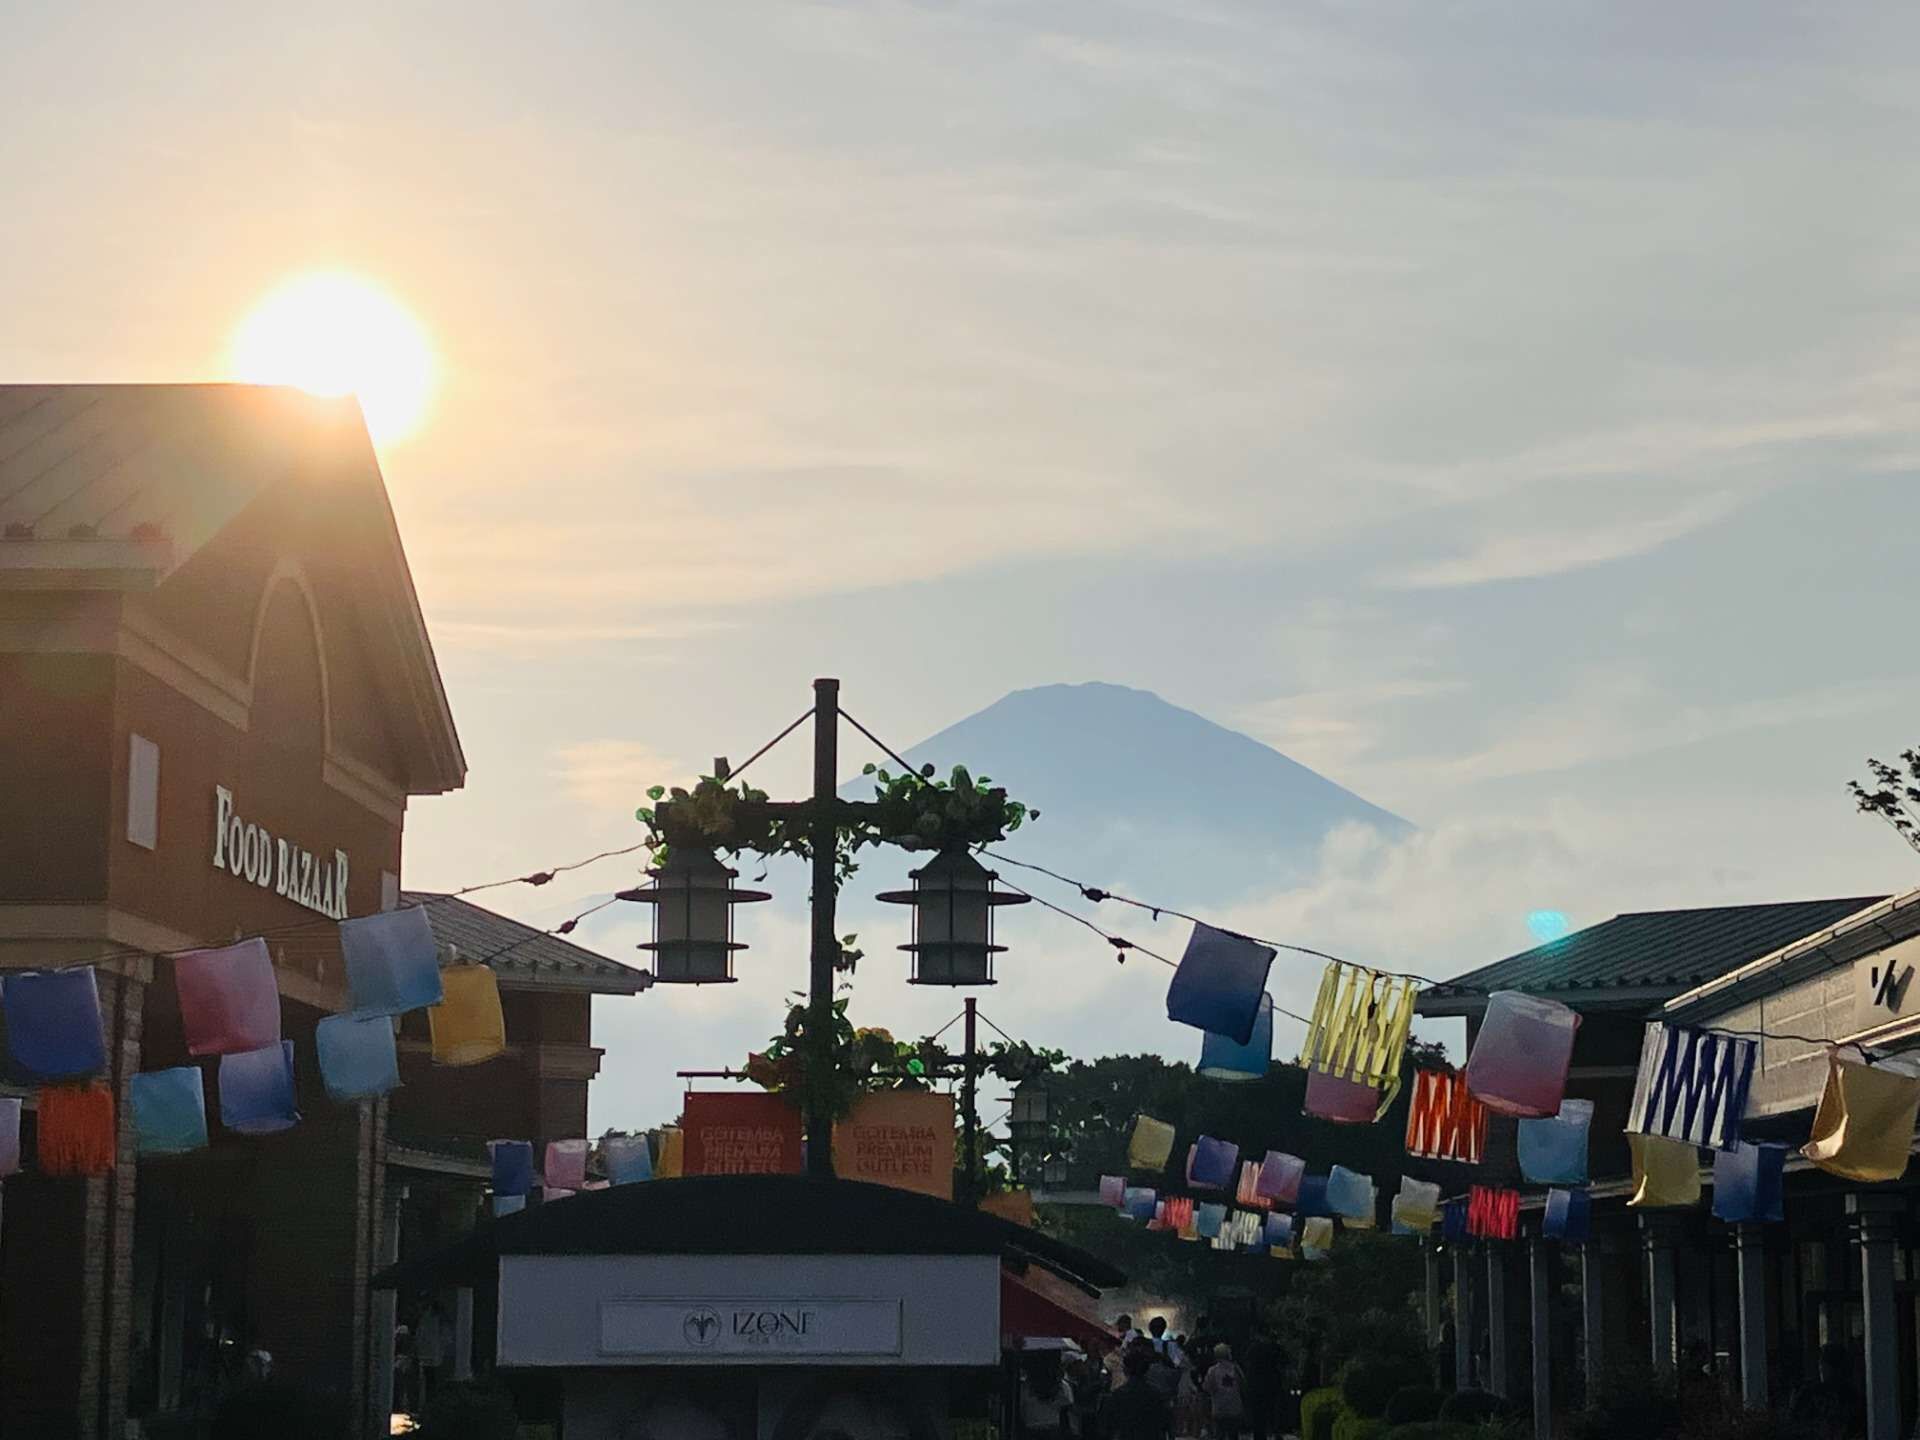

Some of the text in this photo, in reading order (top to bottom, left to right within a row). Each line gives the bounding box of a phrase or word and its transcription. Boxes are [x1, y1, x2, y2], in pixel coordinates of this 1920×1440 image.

[213, 784, 349, 920] FOOD BAZAAR
[856, 1141, 934, 1158] PREMIUM
